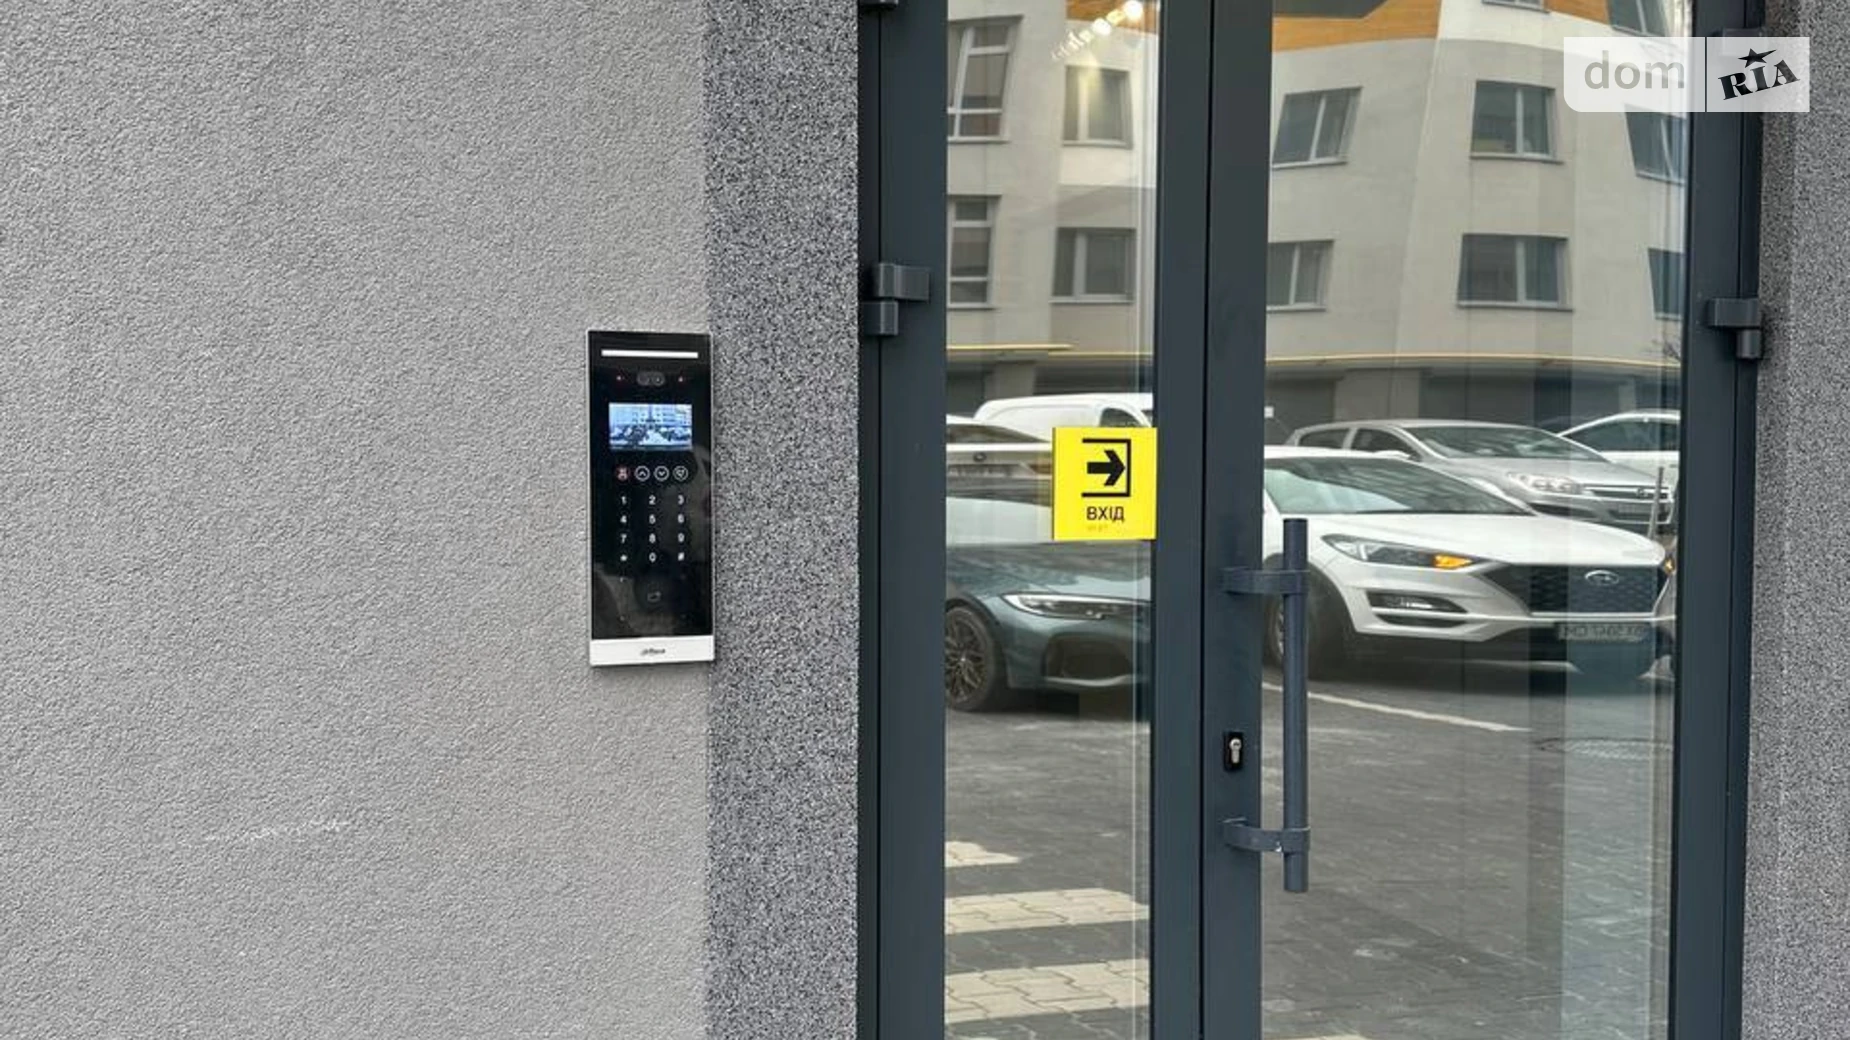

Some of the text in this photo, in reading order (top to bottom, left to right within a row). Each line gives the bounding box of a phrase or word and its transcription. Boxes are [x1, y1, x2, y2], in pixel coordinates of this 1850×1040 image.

[648, 494, 656, 505] 2
[1086, 506, 1125, 523] ВХІД
[620, 533, 627, 544] 7
[648, 552, 656, 563] 0
